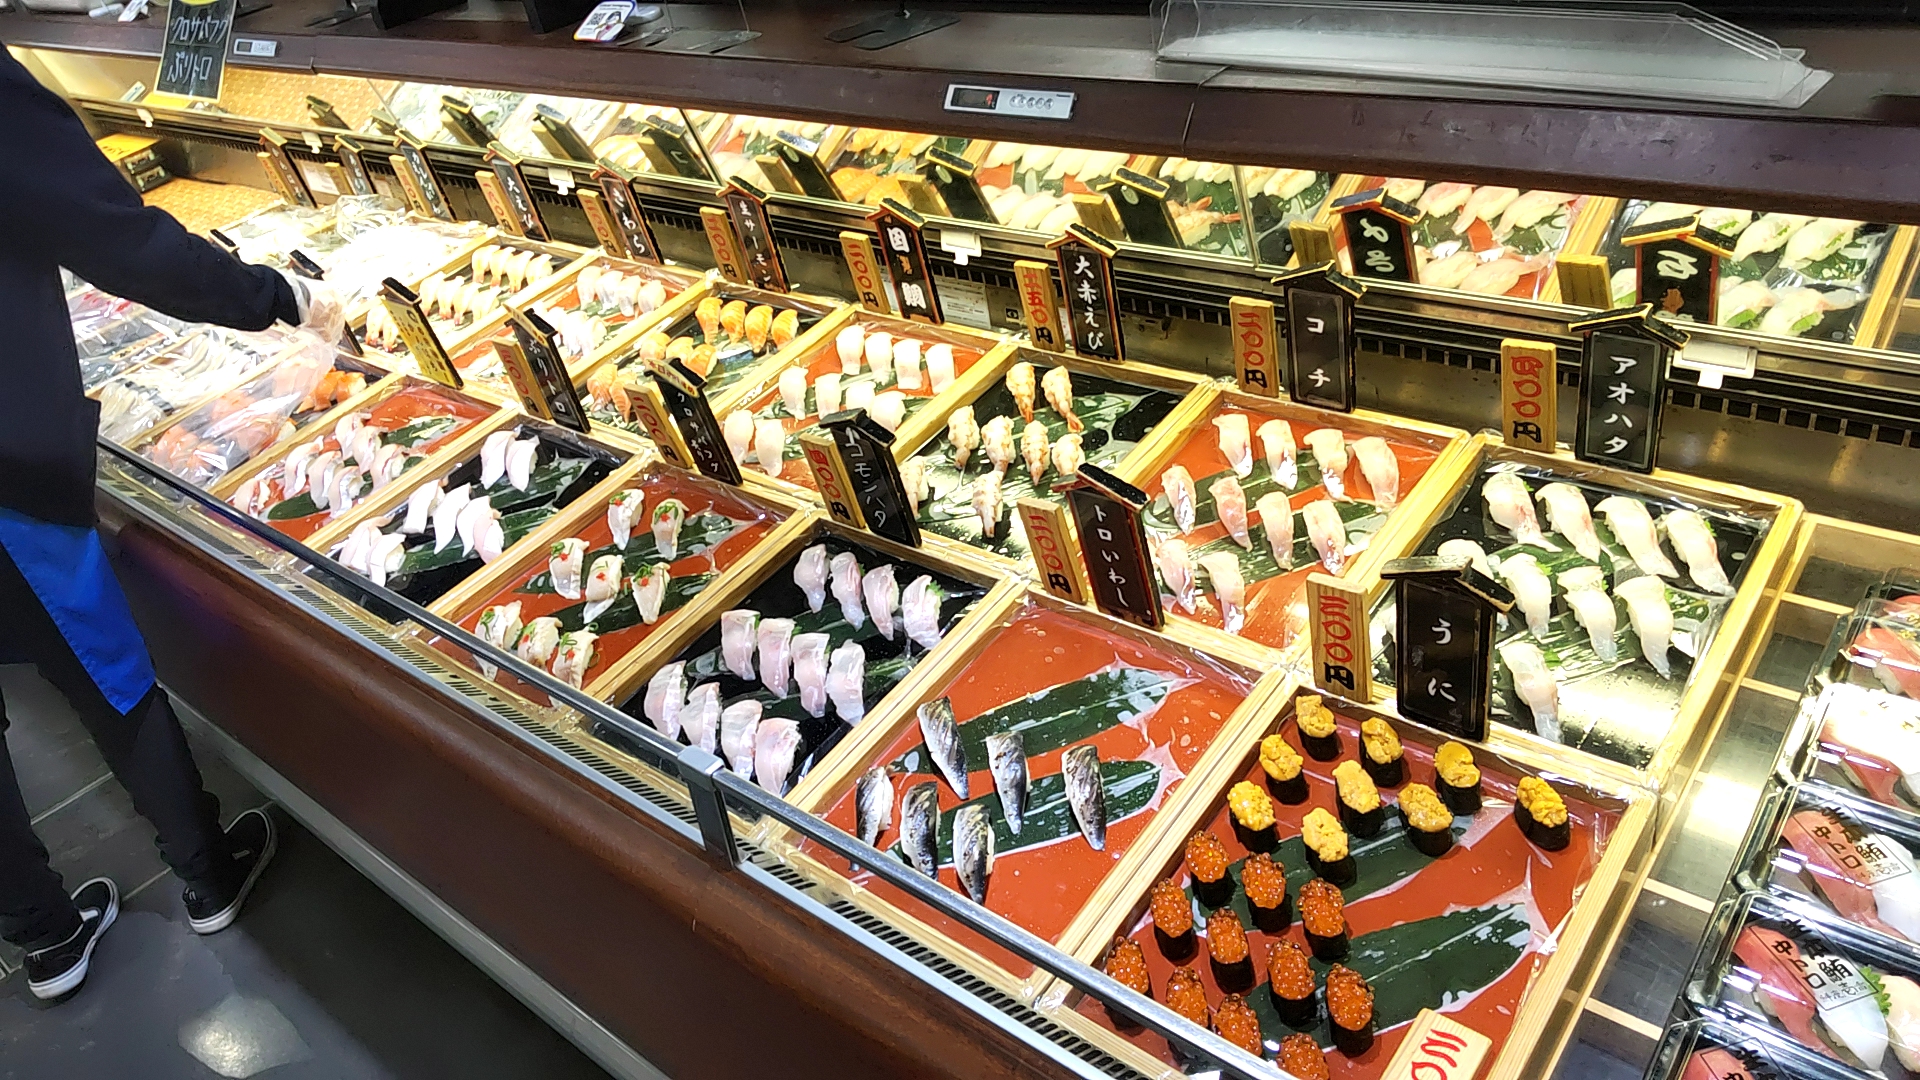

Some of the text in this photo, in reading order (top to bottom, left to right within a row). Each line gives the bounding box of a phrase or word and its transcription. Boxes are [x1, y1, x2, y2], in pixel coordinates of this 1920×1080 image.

[507, 176, 533, 229] 大えび
[613, 187, 647, 255] さわら
[738, 200, 771, 282] 生サーモン
[1073, 255, 1104, 350] 大赤えび
[1306, 317, 1331, 388] コチ
[1604, 355, 1637, 453] アオハタ
[1427, 617, 1456, 703] うに
[1812, 826, 1862, 869] 中トロ
[1771, 940, 1827, 989] 中トロ
